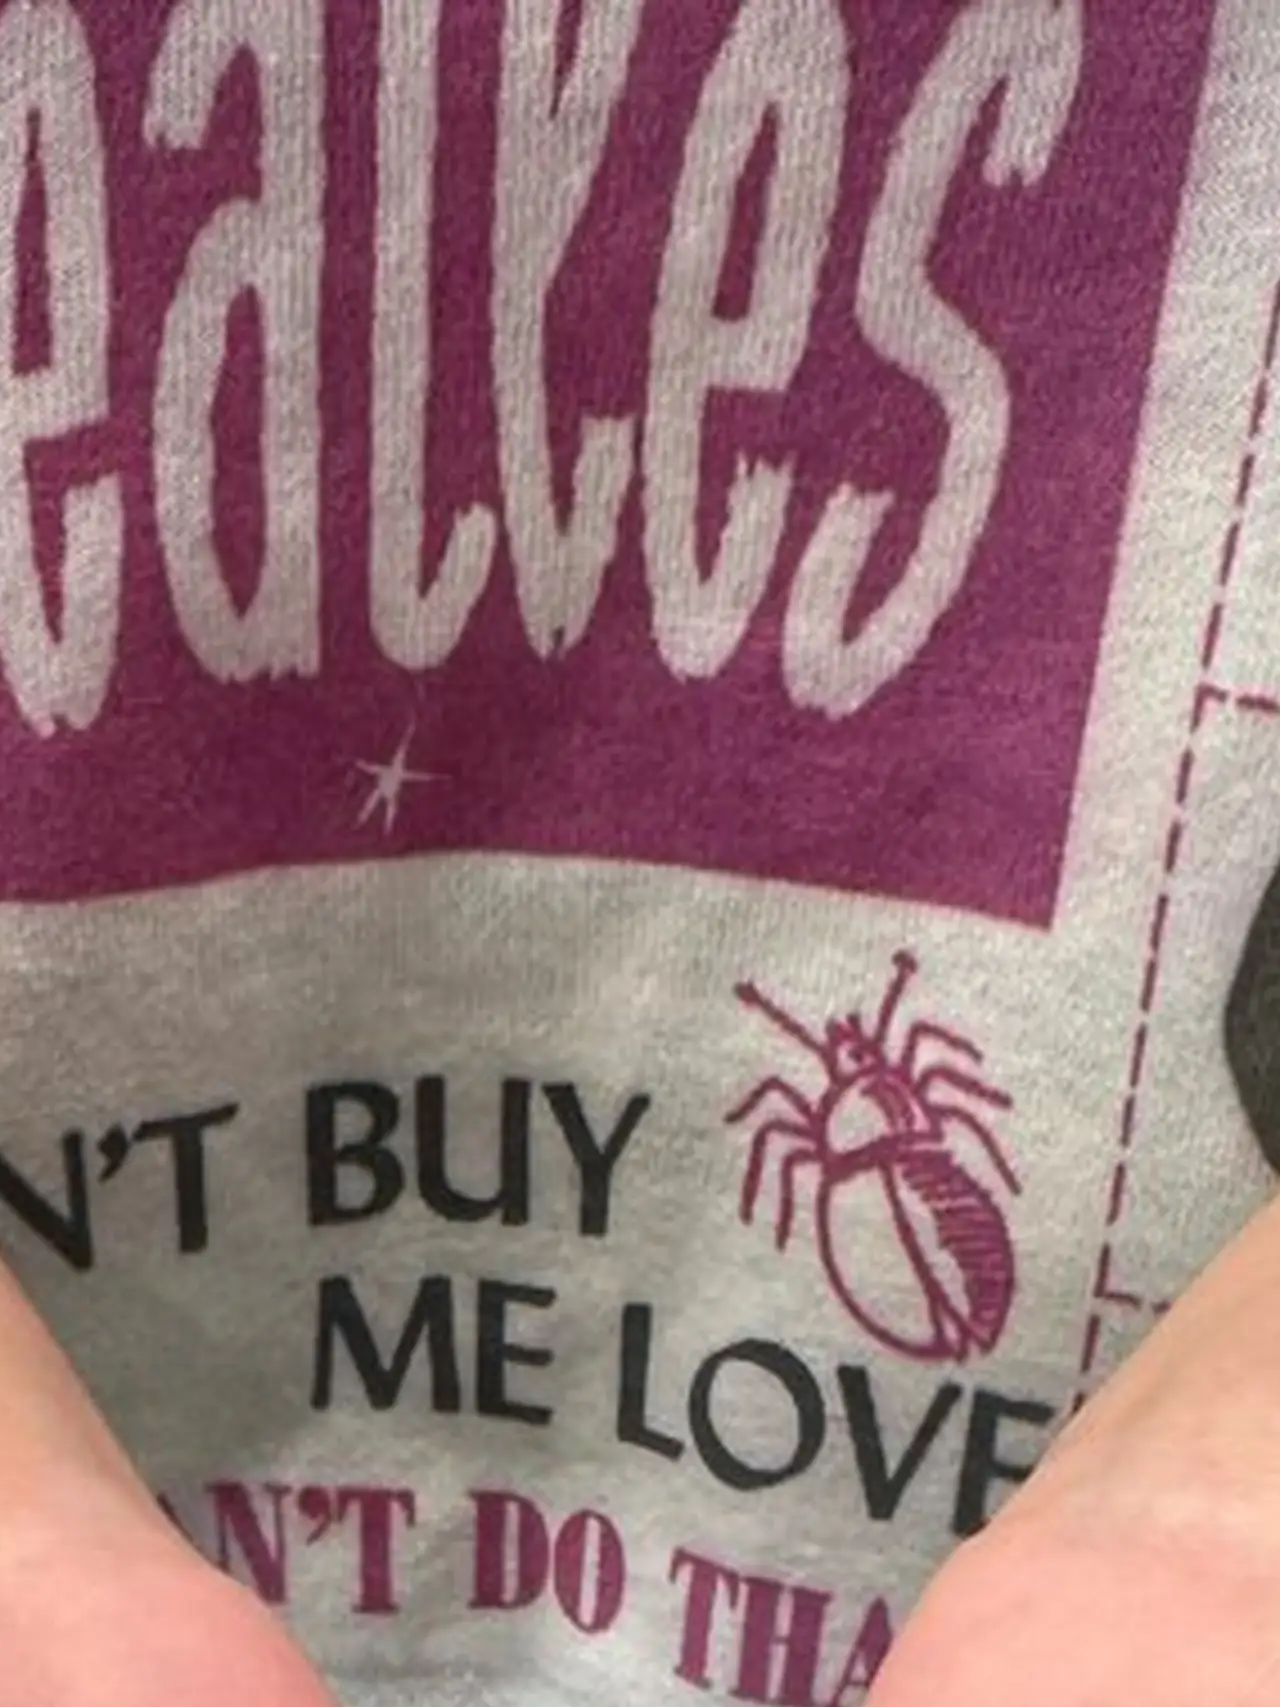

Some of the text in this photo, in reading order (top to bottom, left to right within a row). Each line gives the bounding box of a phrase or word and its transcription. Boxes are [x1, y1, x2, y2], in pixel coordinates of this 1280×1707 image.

[303, 1074, 651, 1236] BUY
[308, 1274, 1056, 1540] ME LOVE
[154, 1480, 416, 1614] N'T
[467, 1487, 627, 1634] DO
